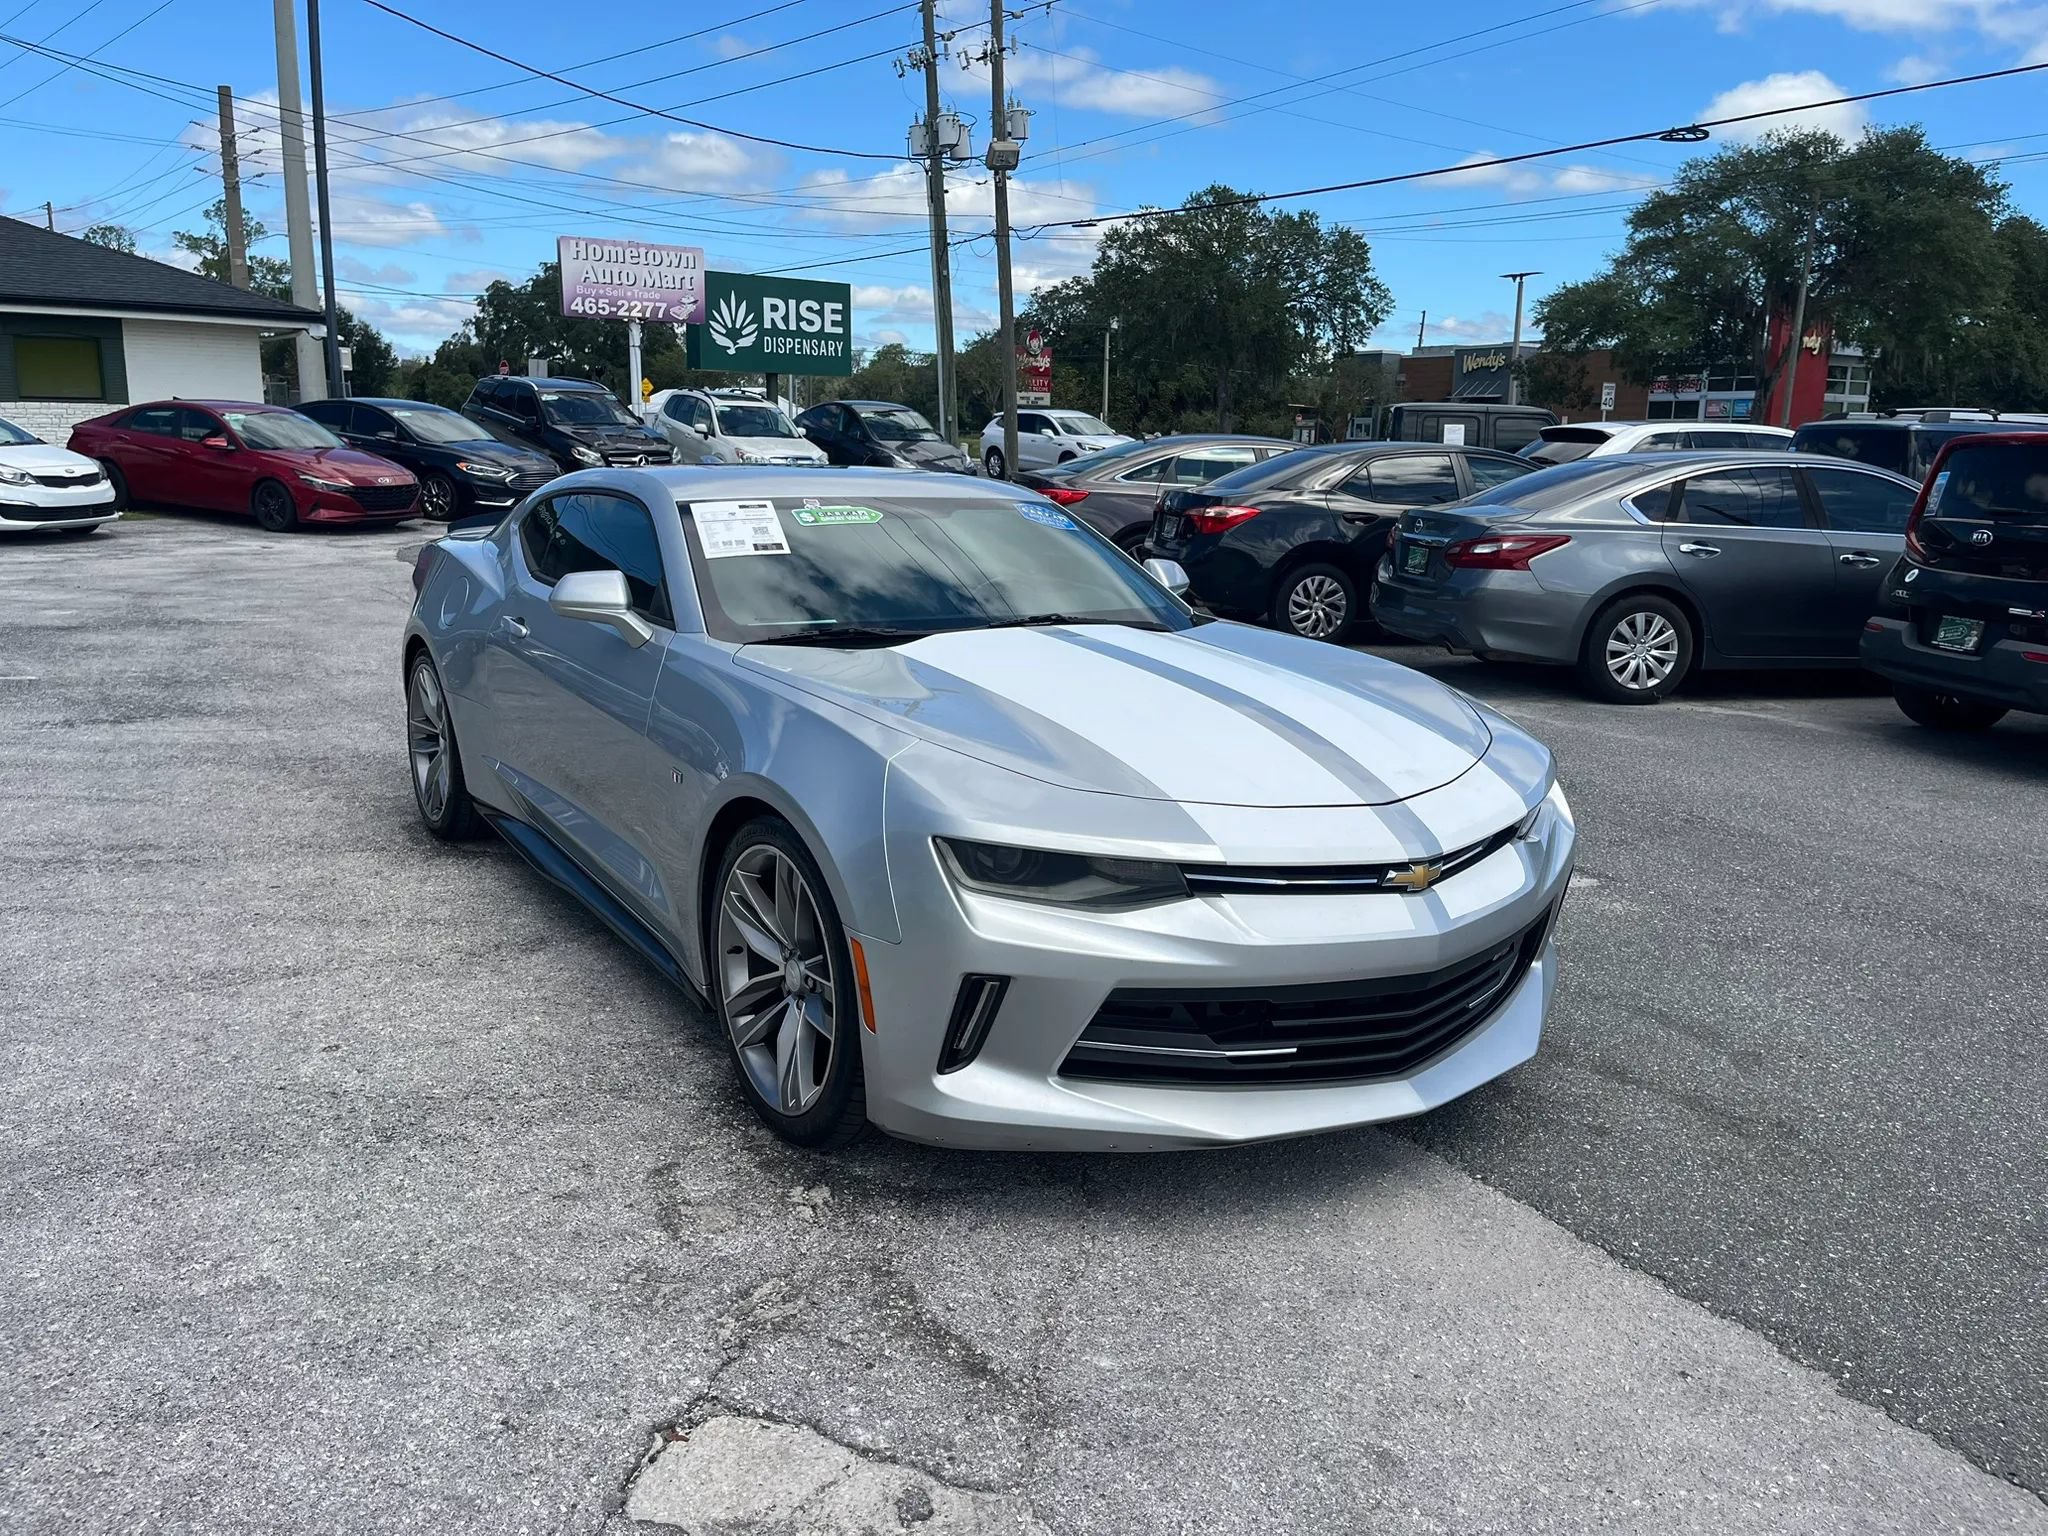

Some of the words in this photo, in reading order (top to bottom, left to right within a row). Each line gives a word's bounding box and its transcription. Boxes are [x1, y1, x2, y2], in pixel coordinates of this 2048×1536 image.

[572, 240, 696, 268] Hometown
[581, 264, 638, 287] Auto
[641, 268, 695, 291] Mart
[576, 285, 597, 297] Buy
[605, 286, 625, 297] Sell
[632, 288, 661, 300] Trade
[570, 296, 668, 319] 465-2277
[762, 296, 843, 334] RISE
[763, 336, 843, 358] DISPENSARY
[1463, 349, 1506, 373] Wendy's
[1602, 397, 1614, 407] 40
[1972, 533, 1987, 543] KIA
